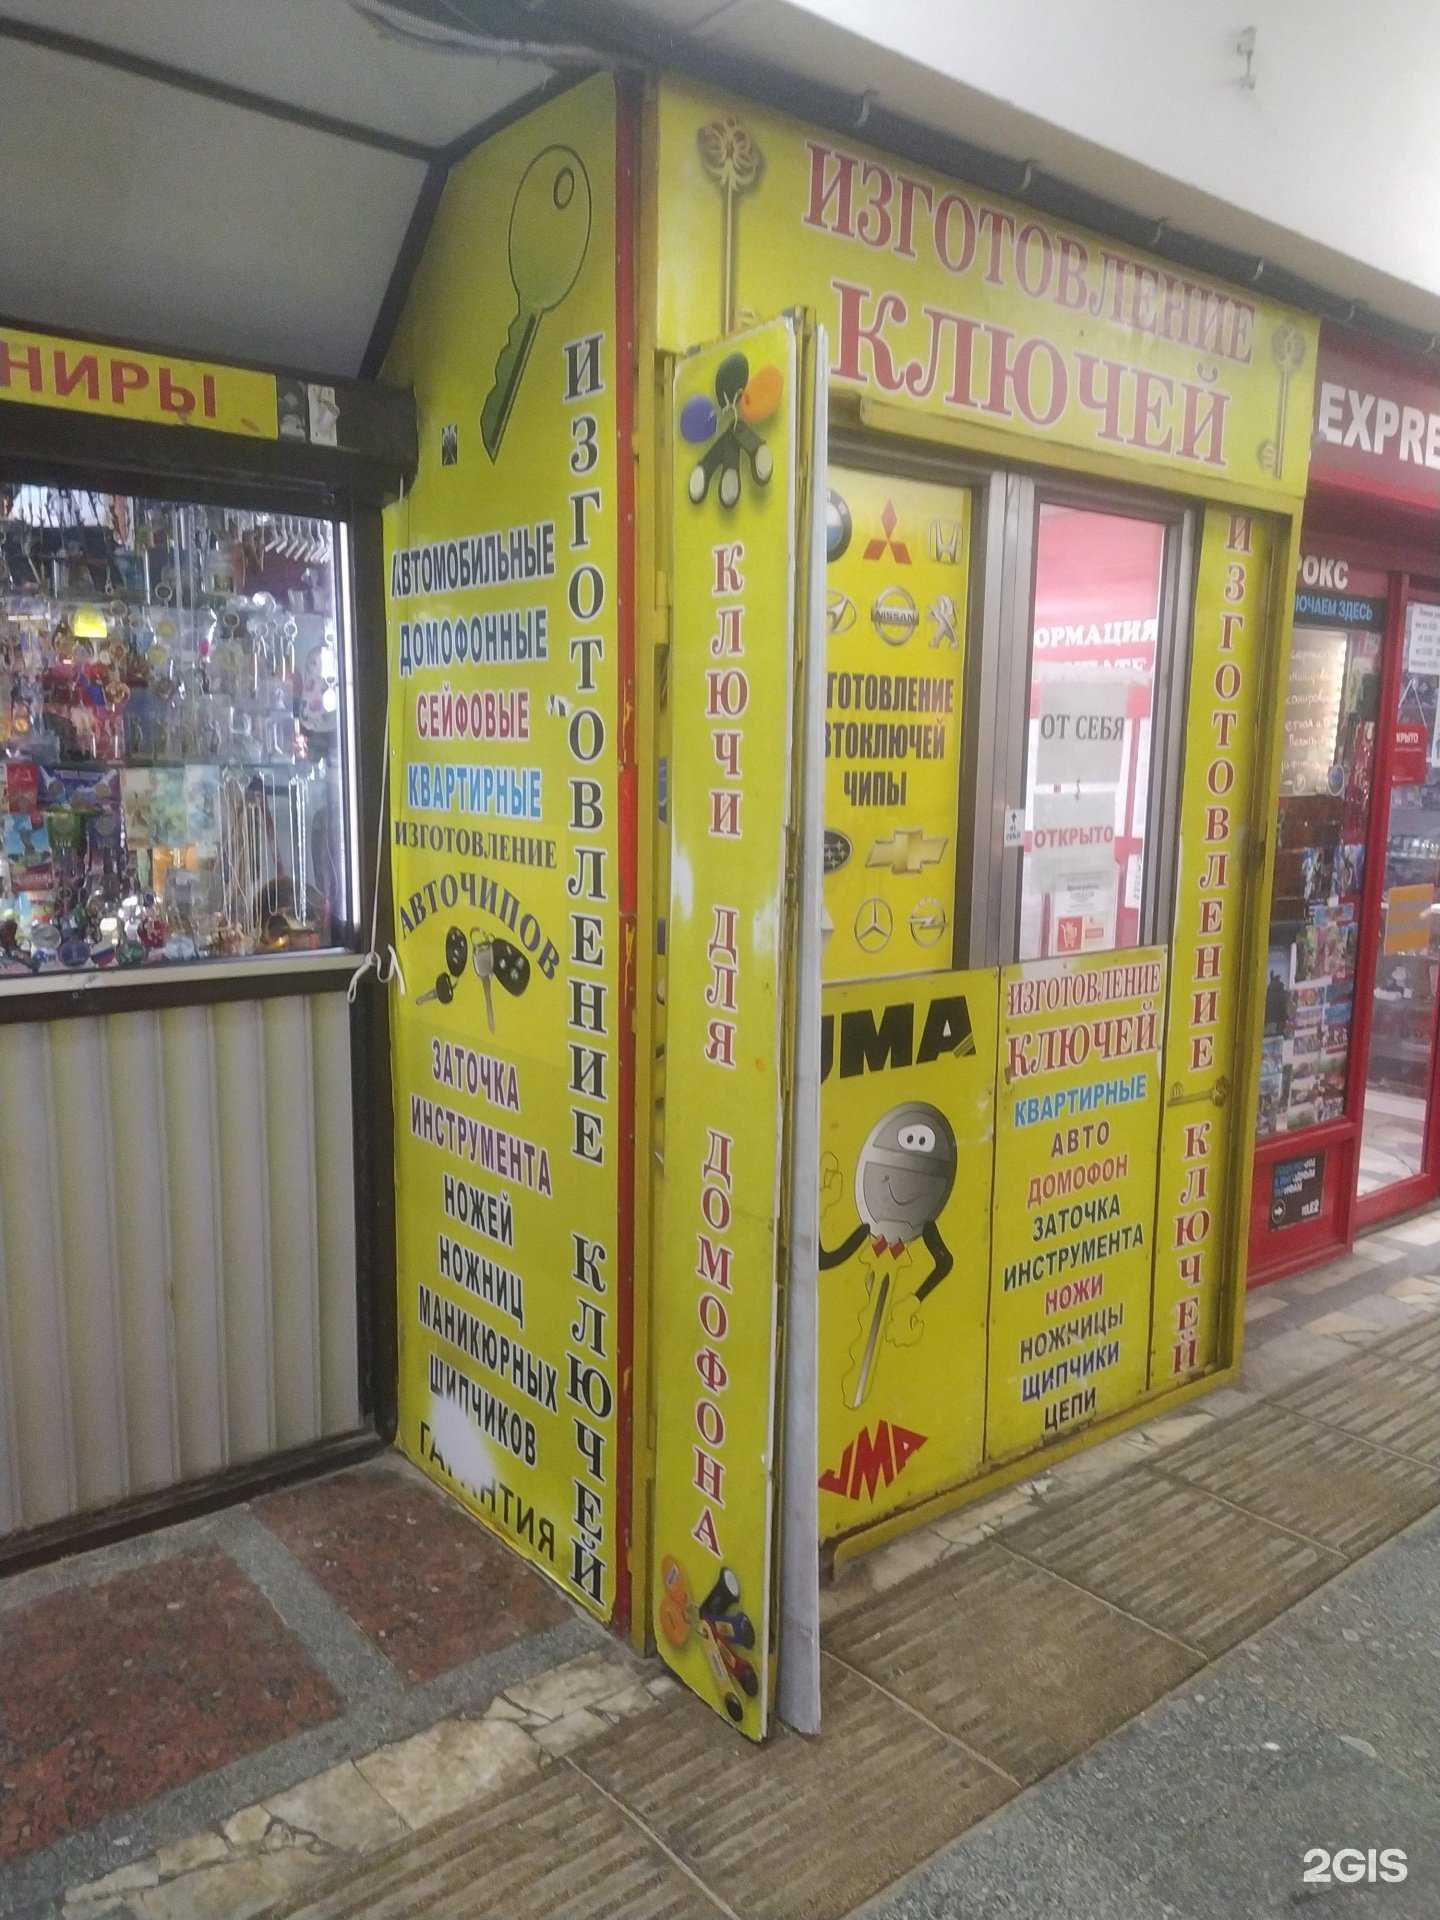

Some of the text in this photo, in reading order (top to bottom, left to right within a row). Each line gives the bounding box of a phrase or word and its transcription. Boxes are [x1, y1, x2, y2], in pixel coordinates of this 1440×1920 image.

[804, 143, 1256, 364] ИЗГОТОВЛЕНИЕ
[0, 341, 216, 418] НИРЫ
[832, 281, 1230, 466] КЛЮЧЕЙ
[391, 525, 555, 597] АВТОМОБИЛЬНЫЕ
[400, 609, 547, 675] ДОМОФОННЫЕ
[417, 684, 529, 737] СЕЙФОВЫЕ
[1041, 714, 1125, 741] ОТ СЕБЯ
[408, 765, 542, 818] КВАРТИРНЫЕ
[844, 771, 907, 806] ЧИПЫ
[395, 821, 556, 868] ИЗГОТОВЛЕНИЕ
[1034, 826, 1114, 848] ОТКРЫТО
[400, 872, 560, 979] АВТОЧИПОВ
[1172, 515, 1252, 1374] ИЗГОТОВЛЕНИЕ КЛЮЧЕЙ
[565, 335, 612, 1605] ИЗГОТОВЛЕНИЕ КЛЮЧЕЙ
[1008, 964, 1160, 1018] ИЗГОТОВЛЕНИЕ
[694, 543, 749, 1557] КЛЮЧИ ДЛЯ ДОМОФОНА
[1007, 1003, 1159, 1080] КЛЮЧЕЙ
[432, 1041, 519, 1110] ЗАТОЧКА
[1014, 1074, 1146, 1127] КВАРТИРНЫЕ
[411, 1096, 552, 1195] ИНСТРУМЕНТА
[1051, 1121, 1110, 1158] АВТО
[444, 1175, 513, 1246] НОЖЕЙ
[1027, 1154, 1128, 1208] ДОМОФОН
[1033, 1194, 1121, 1242] ЗАТОЧКА
[439, 1236, 524, 1328] НОЖНИЦ
[1004, 1223, 1144, 1292] ИНСТРУМЕНТА
[1046, 1274, 1103, 1315] НОЖИ
[419, 1286, 557, 1412] МАНИКЮРНЫХ
[1020, 1302, 1124, 1364] НОЖНИЦЫ
[1022, 1340, 1120, 1402] ЩИПЧИКИ
[1045, 1387, 1097, 1432] ЦЕПИ
